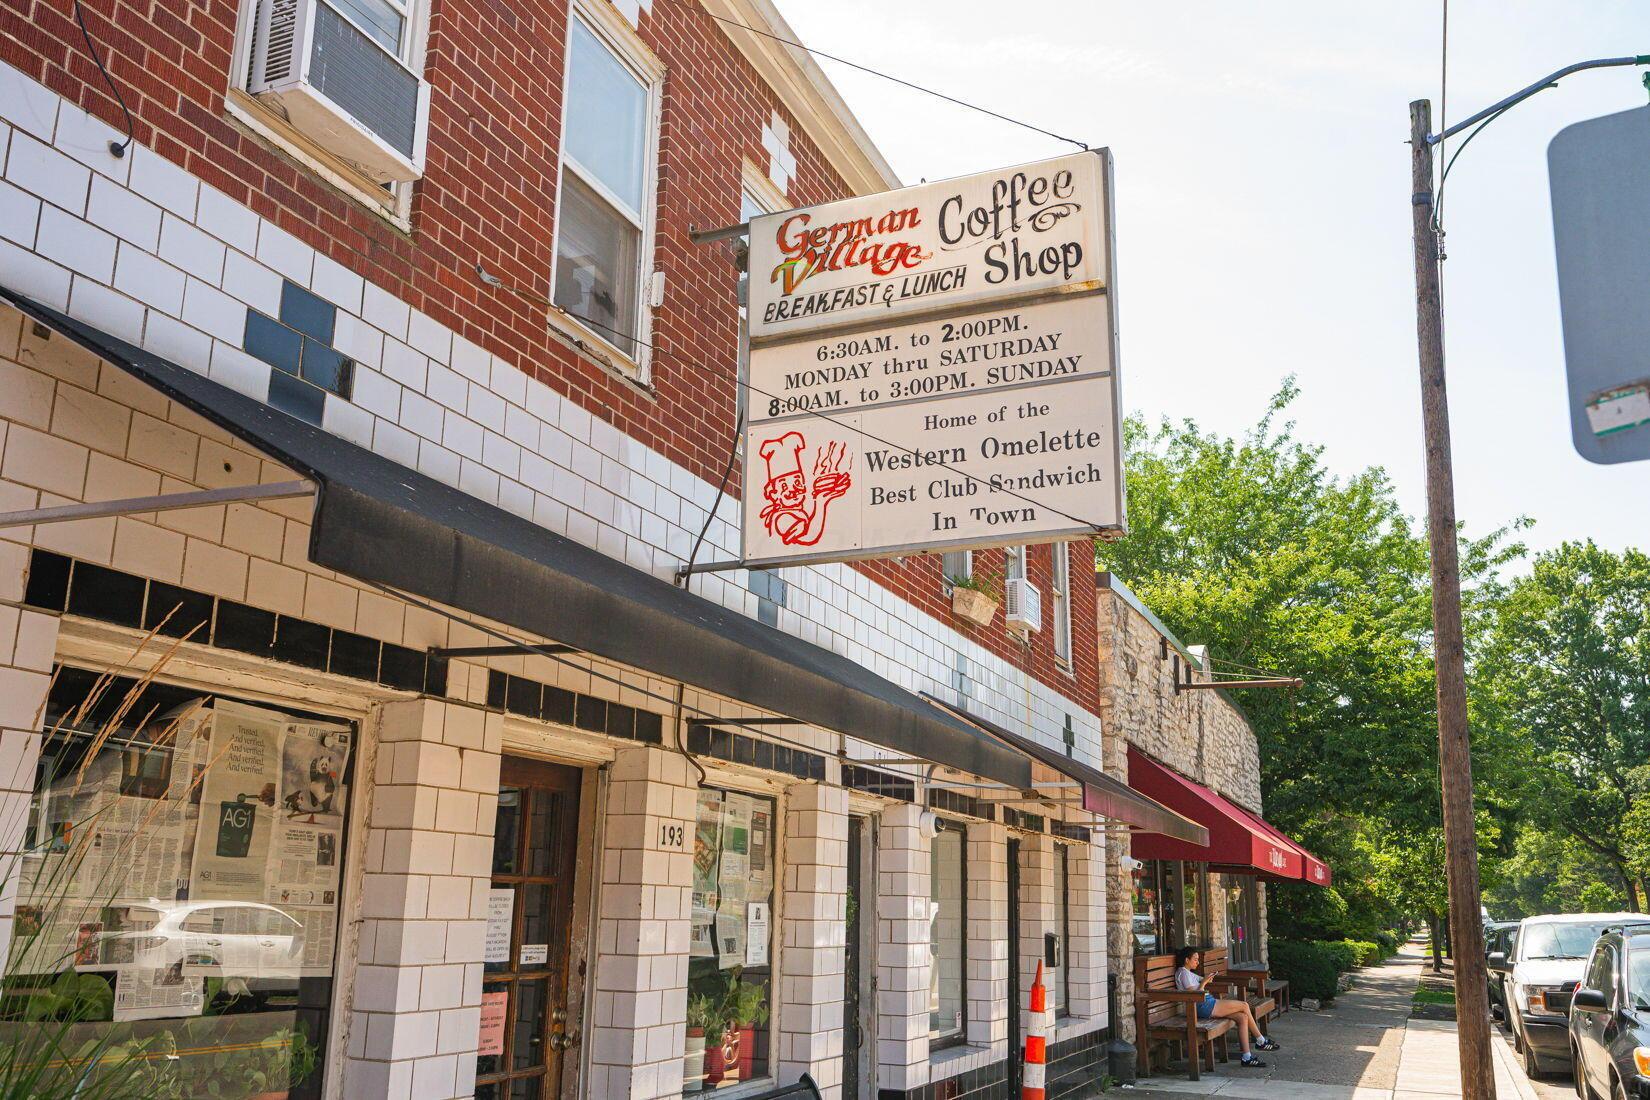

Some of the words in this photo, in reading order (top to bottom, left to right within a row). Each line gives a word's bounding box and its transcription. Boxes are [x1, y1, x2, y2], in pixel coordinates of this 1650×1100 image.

[939, 170, 1074, 245] Coffee
[776, 207, 921, 256] German
[771, 237, 934, 297] Village
[984, 237, 1083, 284] Shop
[763, 283, 880, 322] BREAKFAST
[883, 284, 895, 308] &
[901, 267, 967, 298] LUNCH
[785, 361, 873, 390] MONDAY
[883, 358, 929, 375] thru
[940, 333, 1063, 367] SATURDAY
[816, 335, 899, 362] 6:30AM.
[910, 333, 930, 347] to
[941, 315, 1029, 343] 2:00PM.
[768, 390, 849, 417] 8:00AM.
[860, 388, 879, 402] to
[890, 371, 976, 398] 3:00PM.
[987, 355, 1083, 385] SUNDAY
[924, 414, 977, 431] Home
[987, 405, 1008, 423] of
[1017, 402, 1050, 419] the
[865, 447, 967, 473] Western
[981, 428, 1100, 459] Omelette
[870, 484, 917, 506] Best
[928, 477, 978, 500] Club
[932, 511, 958, 531] In
[970, 507, 1037, 526] Town
[222, 807, 252, 829] AG1
[661, 825, 683, 846] 193
